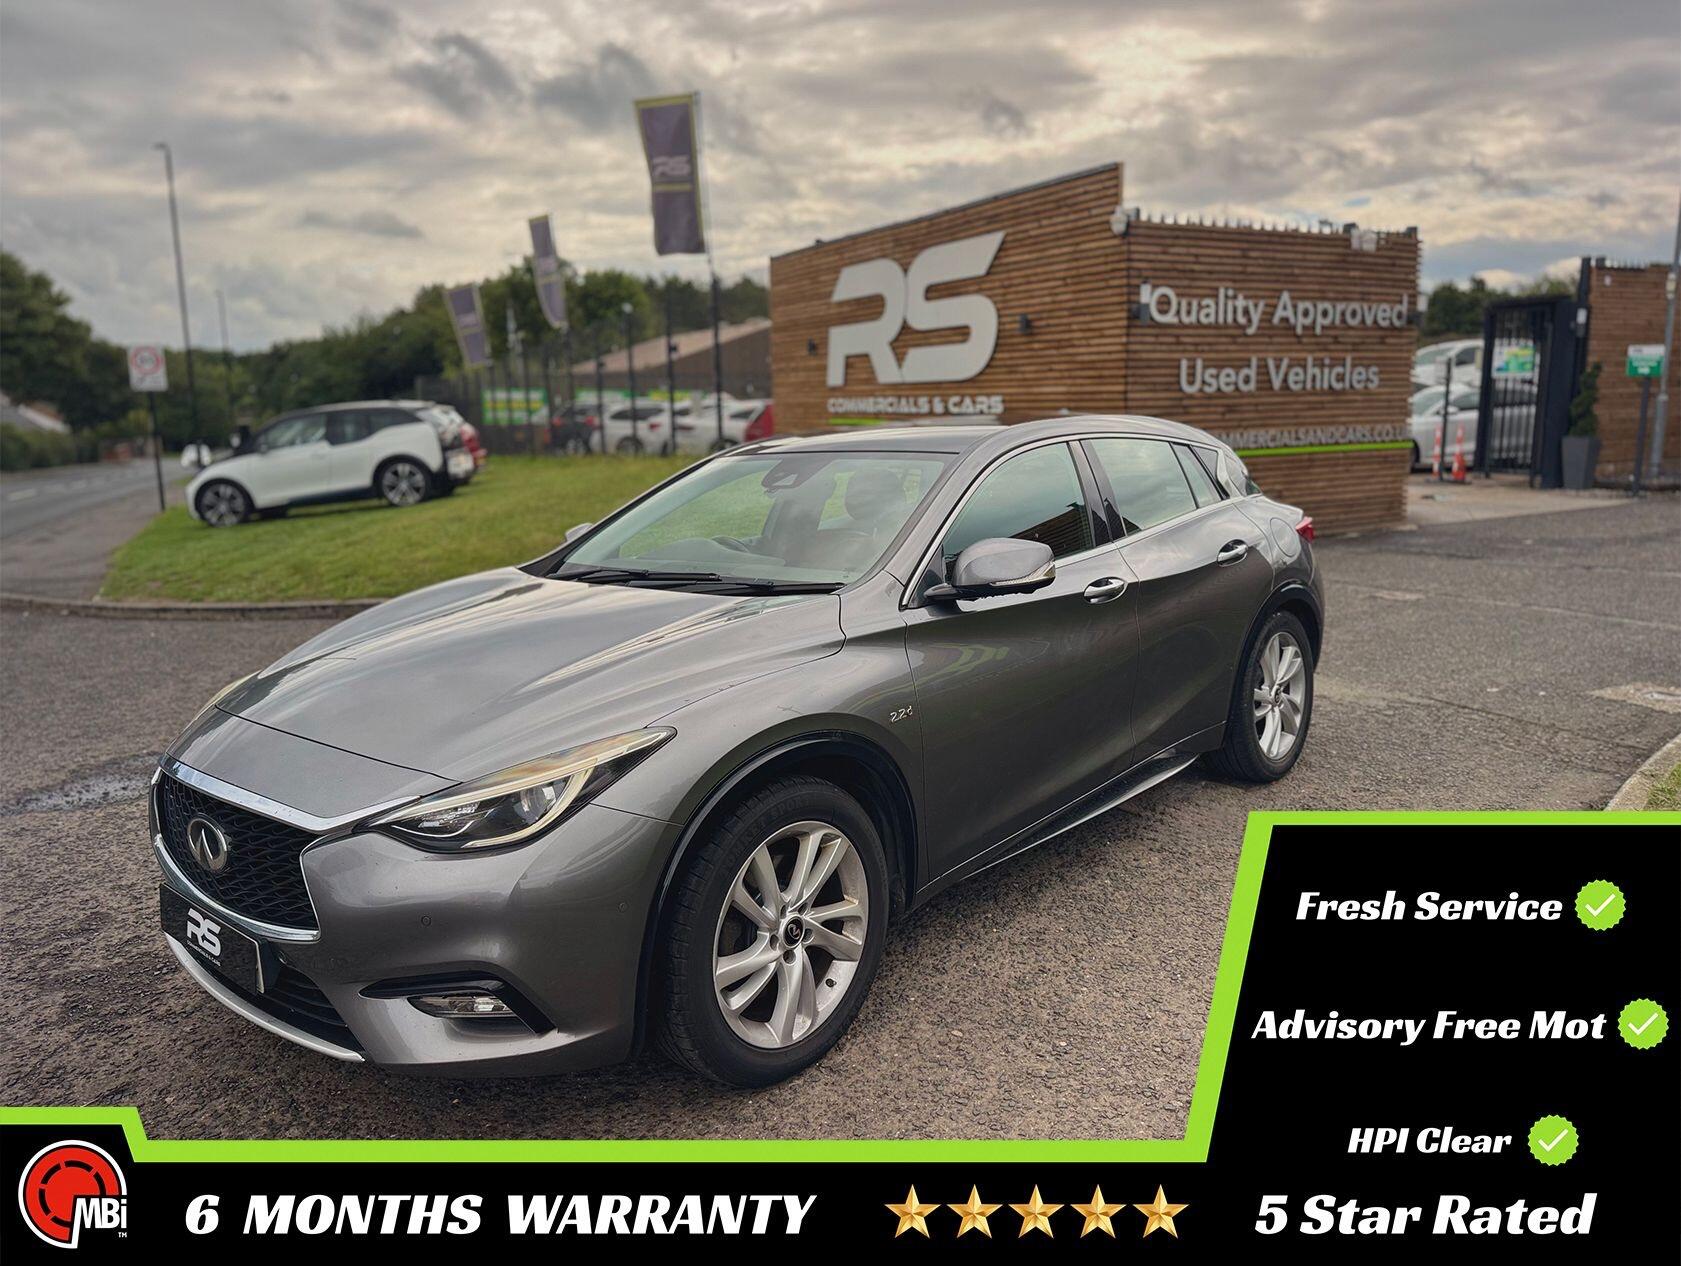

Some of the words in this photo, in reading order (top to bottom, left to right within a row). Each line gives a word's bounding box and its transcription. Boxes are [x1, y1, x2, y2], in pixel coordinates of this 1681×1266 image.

[826, 231, 1006, 388] RS
[1150, 286, 1263, 335] Quality
[1272, 290, 1409, 335] Approved
[1179, 357, 1256, 393] Used
[1267, 355, 1380, 391] Vehicles
[947, 395, 1004, 414] CARS
[187, 908, 221, 957] RS
